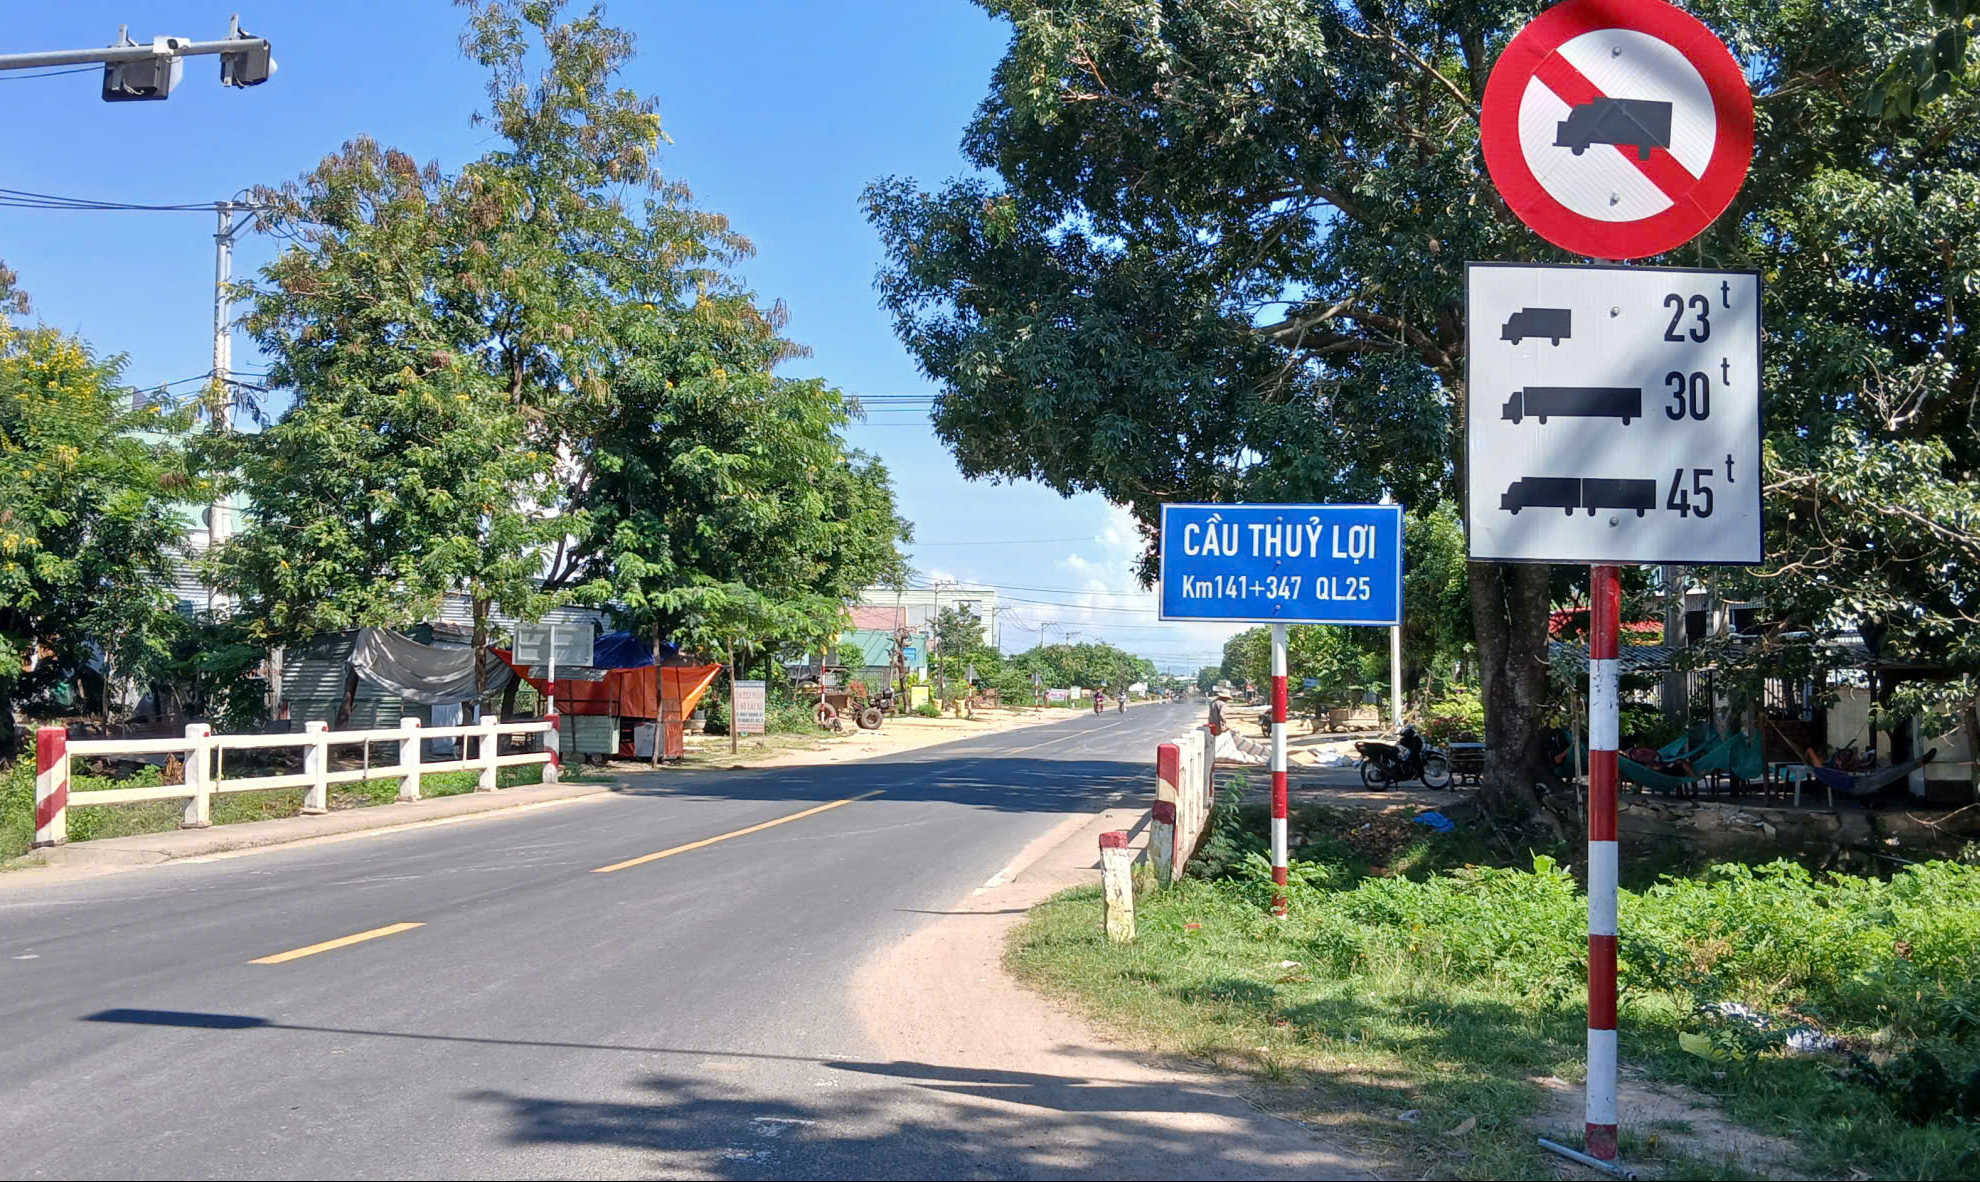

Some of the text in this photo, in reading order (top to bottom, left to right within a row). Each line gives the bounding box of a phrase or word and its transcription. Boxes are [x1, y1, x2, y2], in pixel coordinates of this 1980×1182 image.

[1663, 280, 1730, 343] 23 t
[1665, 357, 1730, 421] 30 t
[1666, 454, 1735, 518] 45 t
[1183, 512, 1376, 564] CẦU THUỶ LỢI
[1182, 575, 1371, 601] Km141+347 QL25
